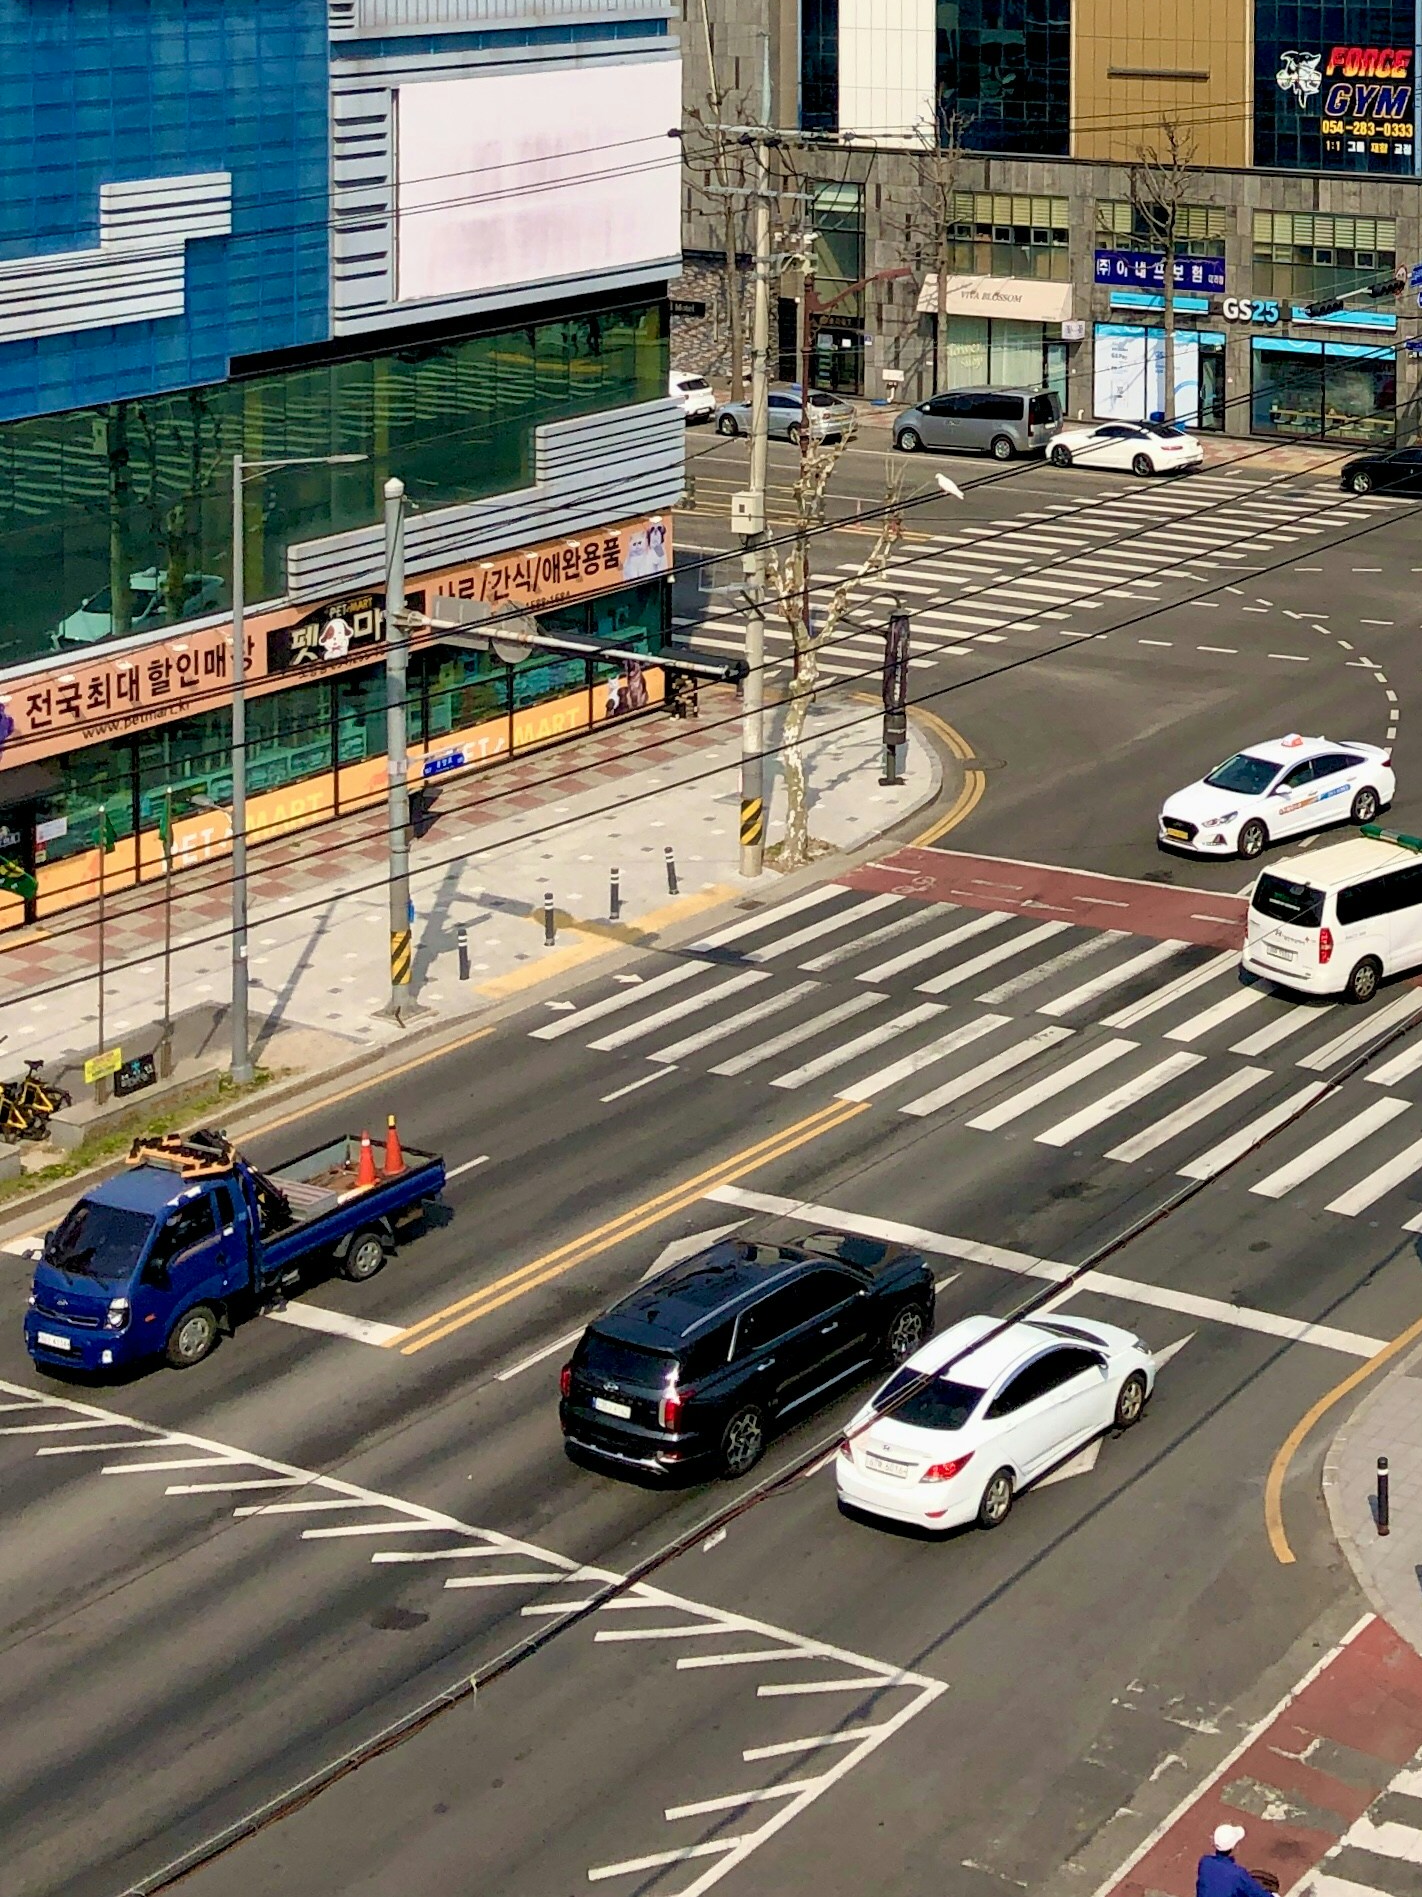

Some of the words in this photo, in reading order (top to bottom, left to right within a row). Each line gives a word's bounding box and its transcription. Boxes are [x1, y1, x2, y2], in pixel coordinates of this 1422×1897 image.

[1326, 47, 1412, 78] FORCE
[1325, 82, 1411, 119] GYM
[1321, 119, 1413, 138] 054-283-0333
[1325, 140, 1340, 151] 1:1
[1222, 297, 1280, 323] GS25
[290, 607, 386, 666] 펫마
[26, 664, 140, 730] 전국최대
[515, 706, 581, 747] MART
[246, 791, 325, 841] MART
